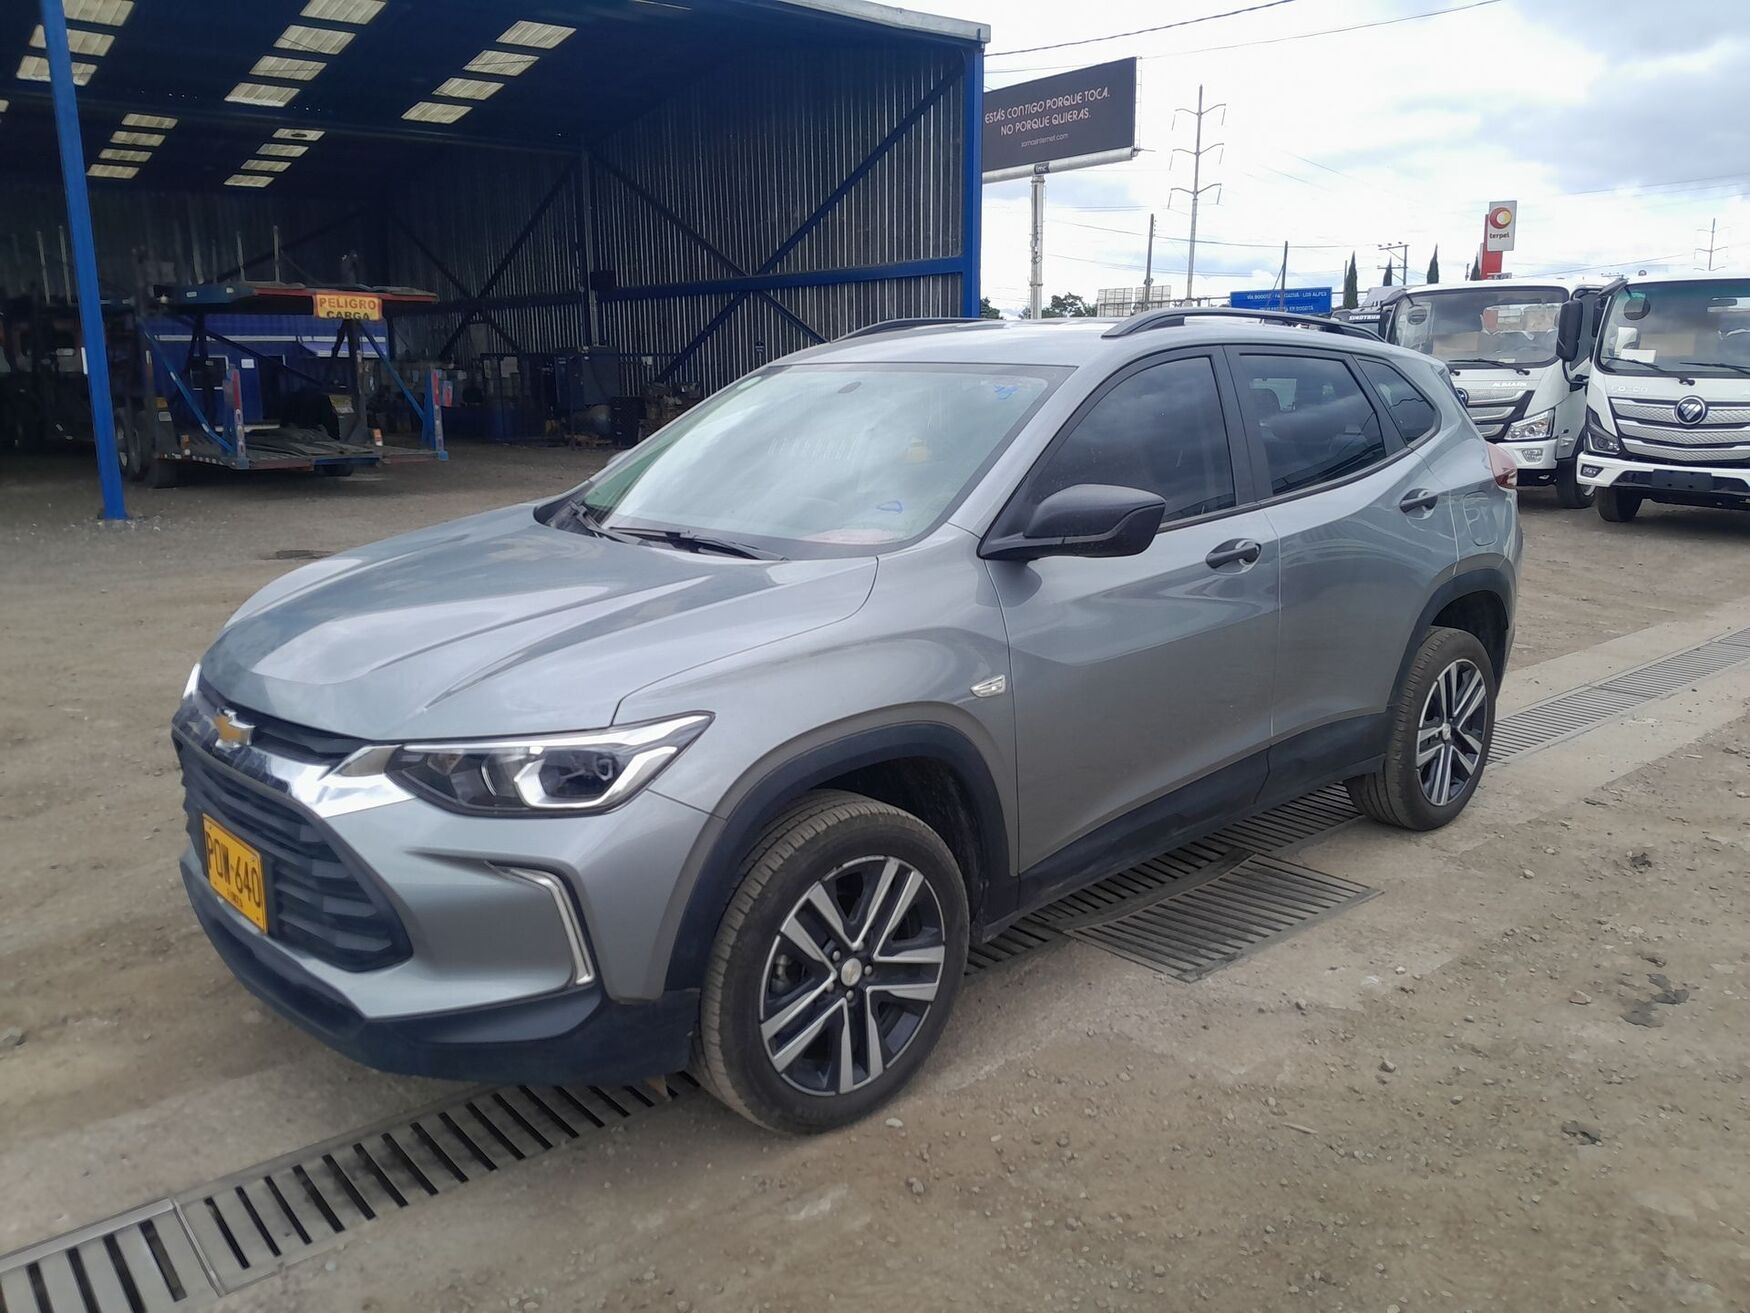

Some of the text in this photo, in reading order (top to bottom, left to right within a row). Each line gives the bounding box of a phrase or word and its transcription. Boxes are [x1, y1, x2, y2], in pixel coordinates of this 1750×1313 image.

[985, 87, 1110, 124] ESTÁS CONTIGO PORQUE TOCA.
[1001, 108, 1092, 136] NO PORQUE QUIERAS.
[1489, 232, 1510, 240] terpel
[319, 297, 377, 310] PELIGRO
[326, 310, 370, 320] CARGA
